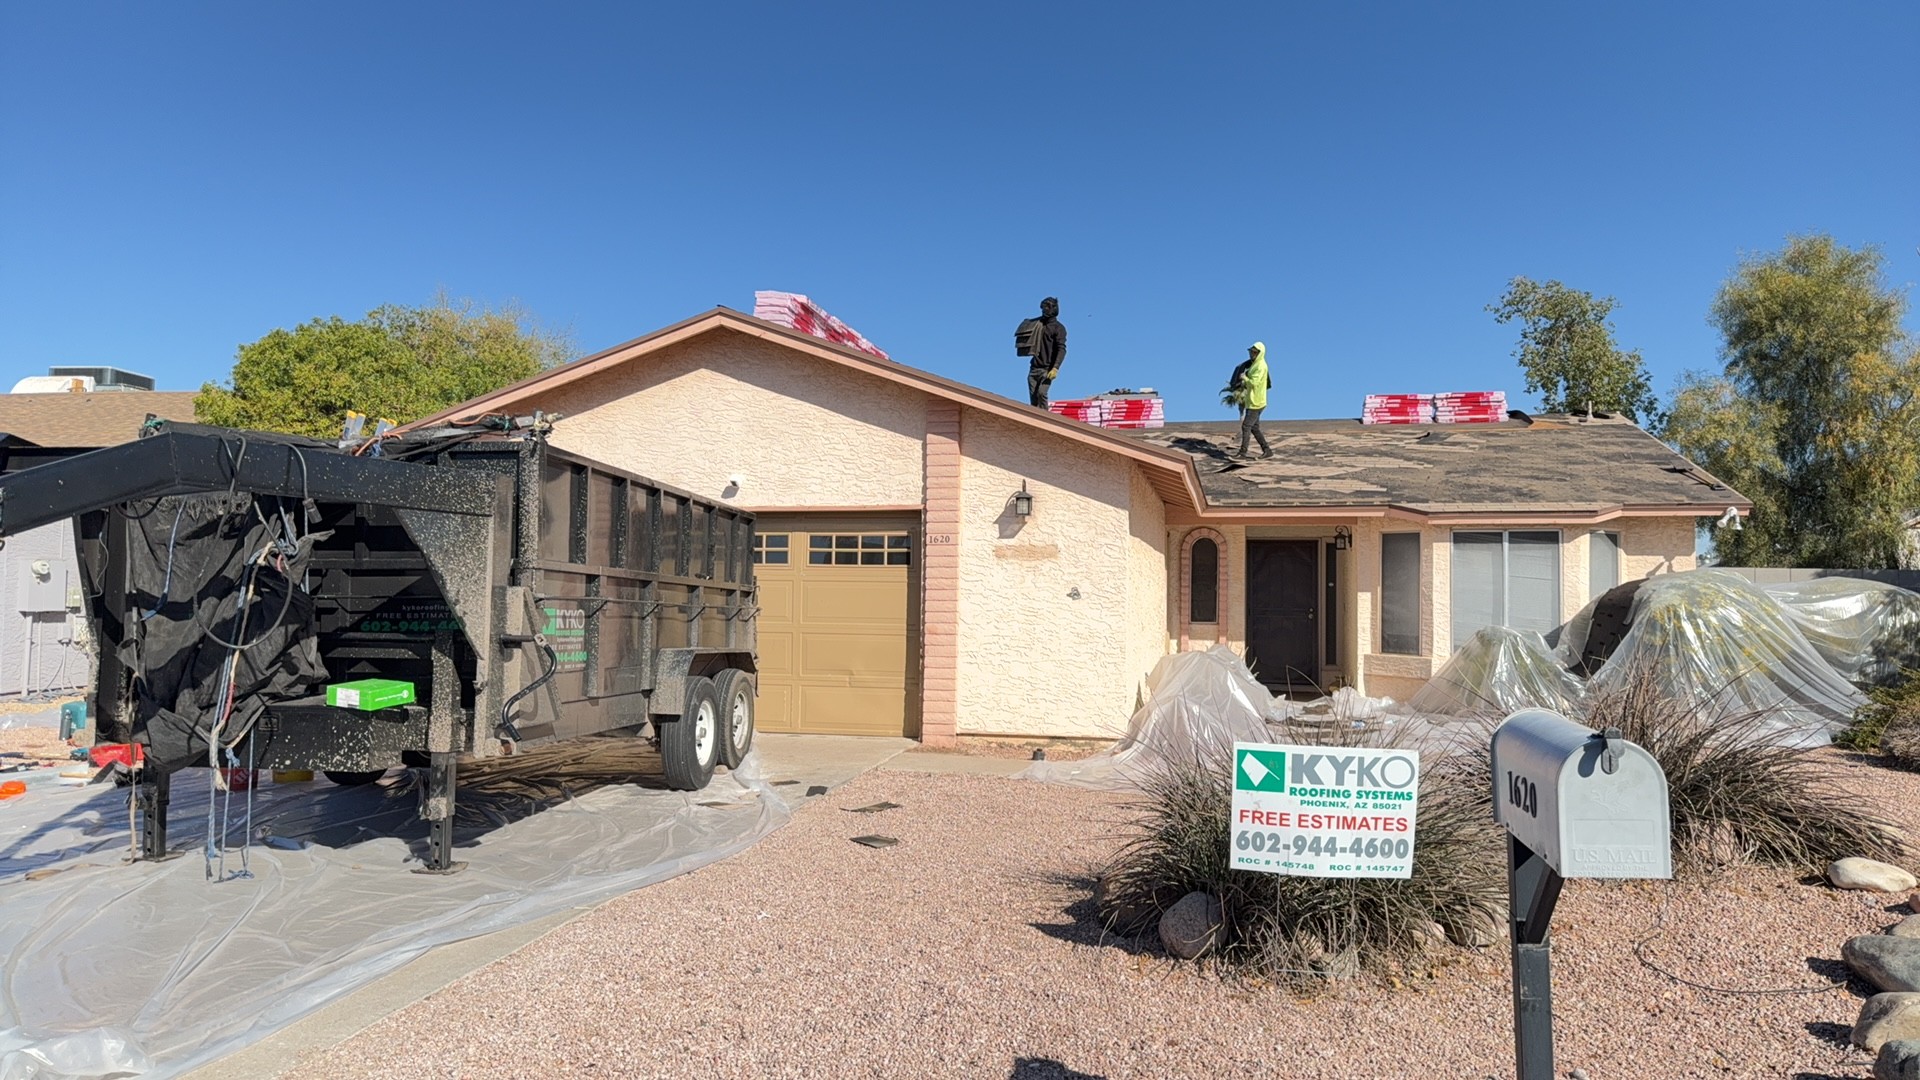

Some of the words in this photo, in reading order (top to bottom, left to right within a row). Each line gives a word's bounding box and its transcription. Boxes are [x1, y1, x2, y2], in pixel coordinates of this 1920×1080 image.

[929, 535, 950, 543] 1620
[361, 620, 459, 631] 602-944-46
[1291, 753, 1415, 789] KY-KO
[1289, 787, 1351, 799] ROOFING
[1356, 790, 1413, 801] SYSTEMS
[1507, 771, 1537, 818] 1620
[1300, 800, 1350, 809] PHOENIX,
[1372, 802, 1402, 810] 85021
[1239, 809, 1291, 827] FREE
[1297, 814, 1408, 832] ESTIMATES
[1236, 830, 1409, 859] 602-944-4600
[1238, 857, 1260, 865] ROC
[1276, 860, 1315, 870] 145748
[1572, 848, 1601, 863] U.S.
[1605, 848, 1657, 864] MAIL
